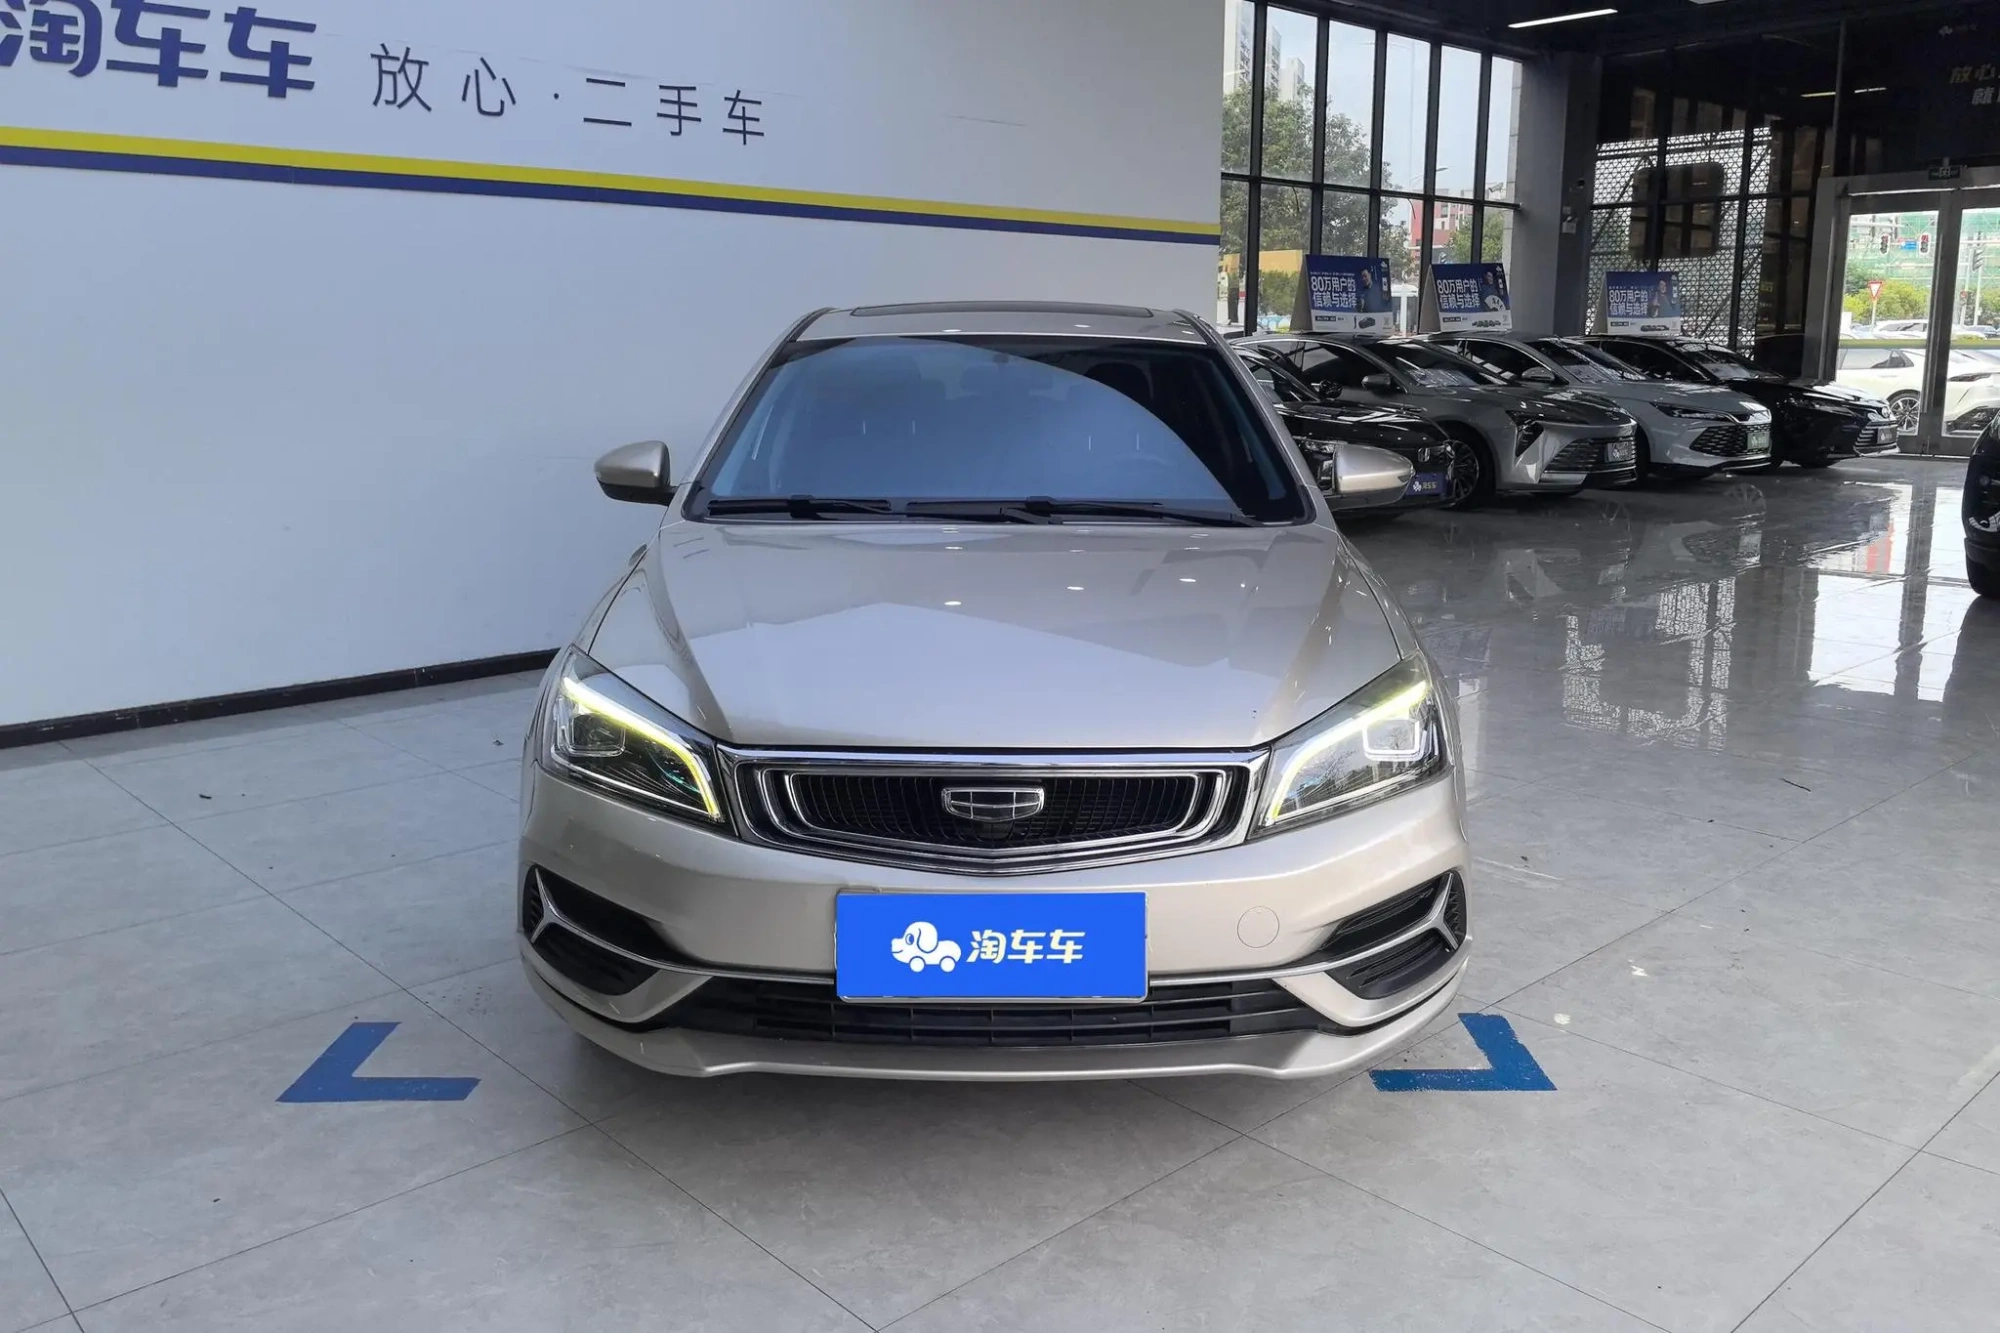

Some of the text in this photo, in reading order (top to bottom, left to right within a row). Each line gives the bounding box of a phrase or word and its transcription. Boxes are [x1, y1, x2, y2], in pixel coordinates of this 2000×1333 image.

[0, 0, 317, 99] 淘车车
[1311, 276, 1356, 292] 80万用户的
[1436, 278, 1478, 294] 80万用户的
[1312, 291, 1357, 308] 信赖与选择
[1608, 289, 1648, 303] 80万用户的
